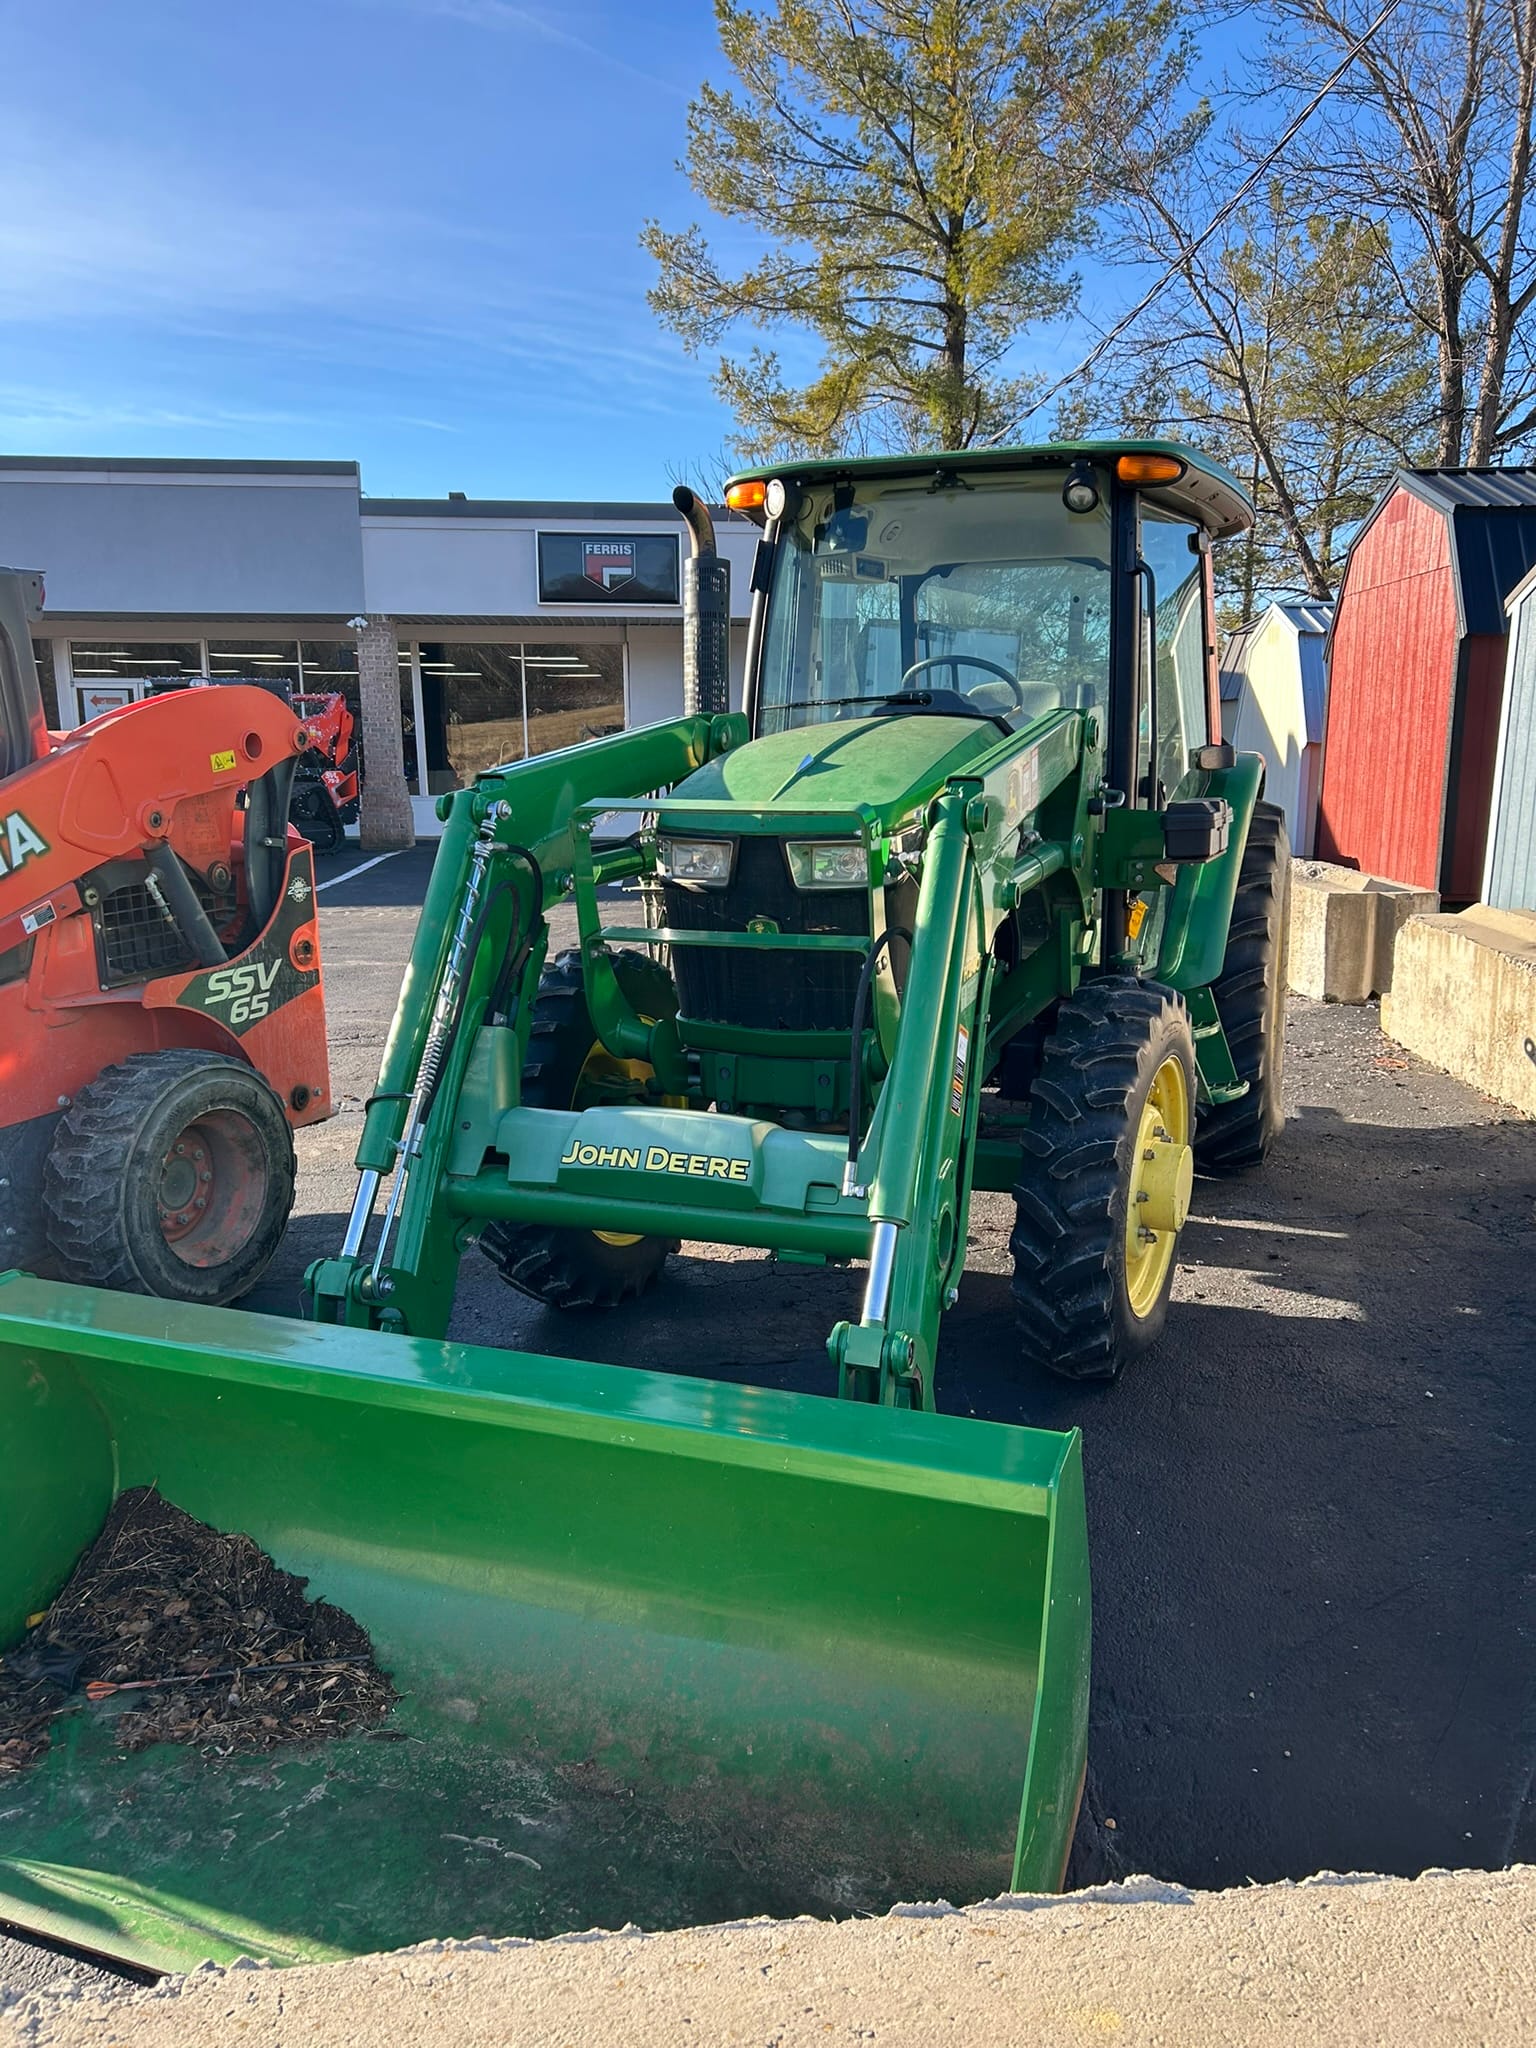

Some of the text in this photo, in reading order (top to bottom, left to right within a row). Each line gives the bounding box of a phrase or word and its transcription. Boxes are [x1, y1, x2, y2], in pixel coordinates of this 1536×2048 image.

[585, 544, 632, 555] FERRIS
[204, 958, 283, 1005] SSV
[230, 992, 270, 1024] 65
[561, 1140, 751, 1181] JOHN DEERE
